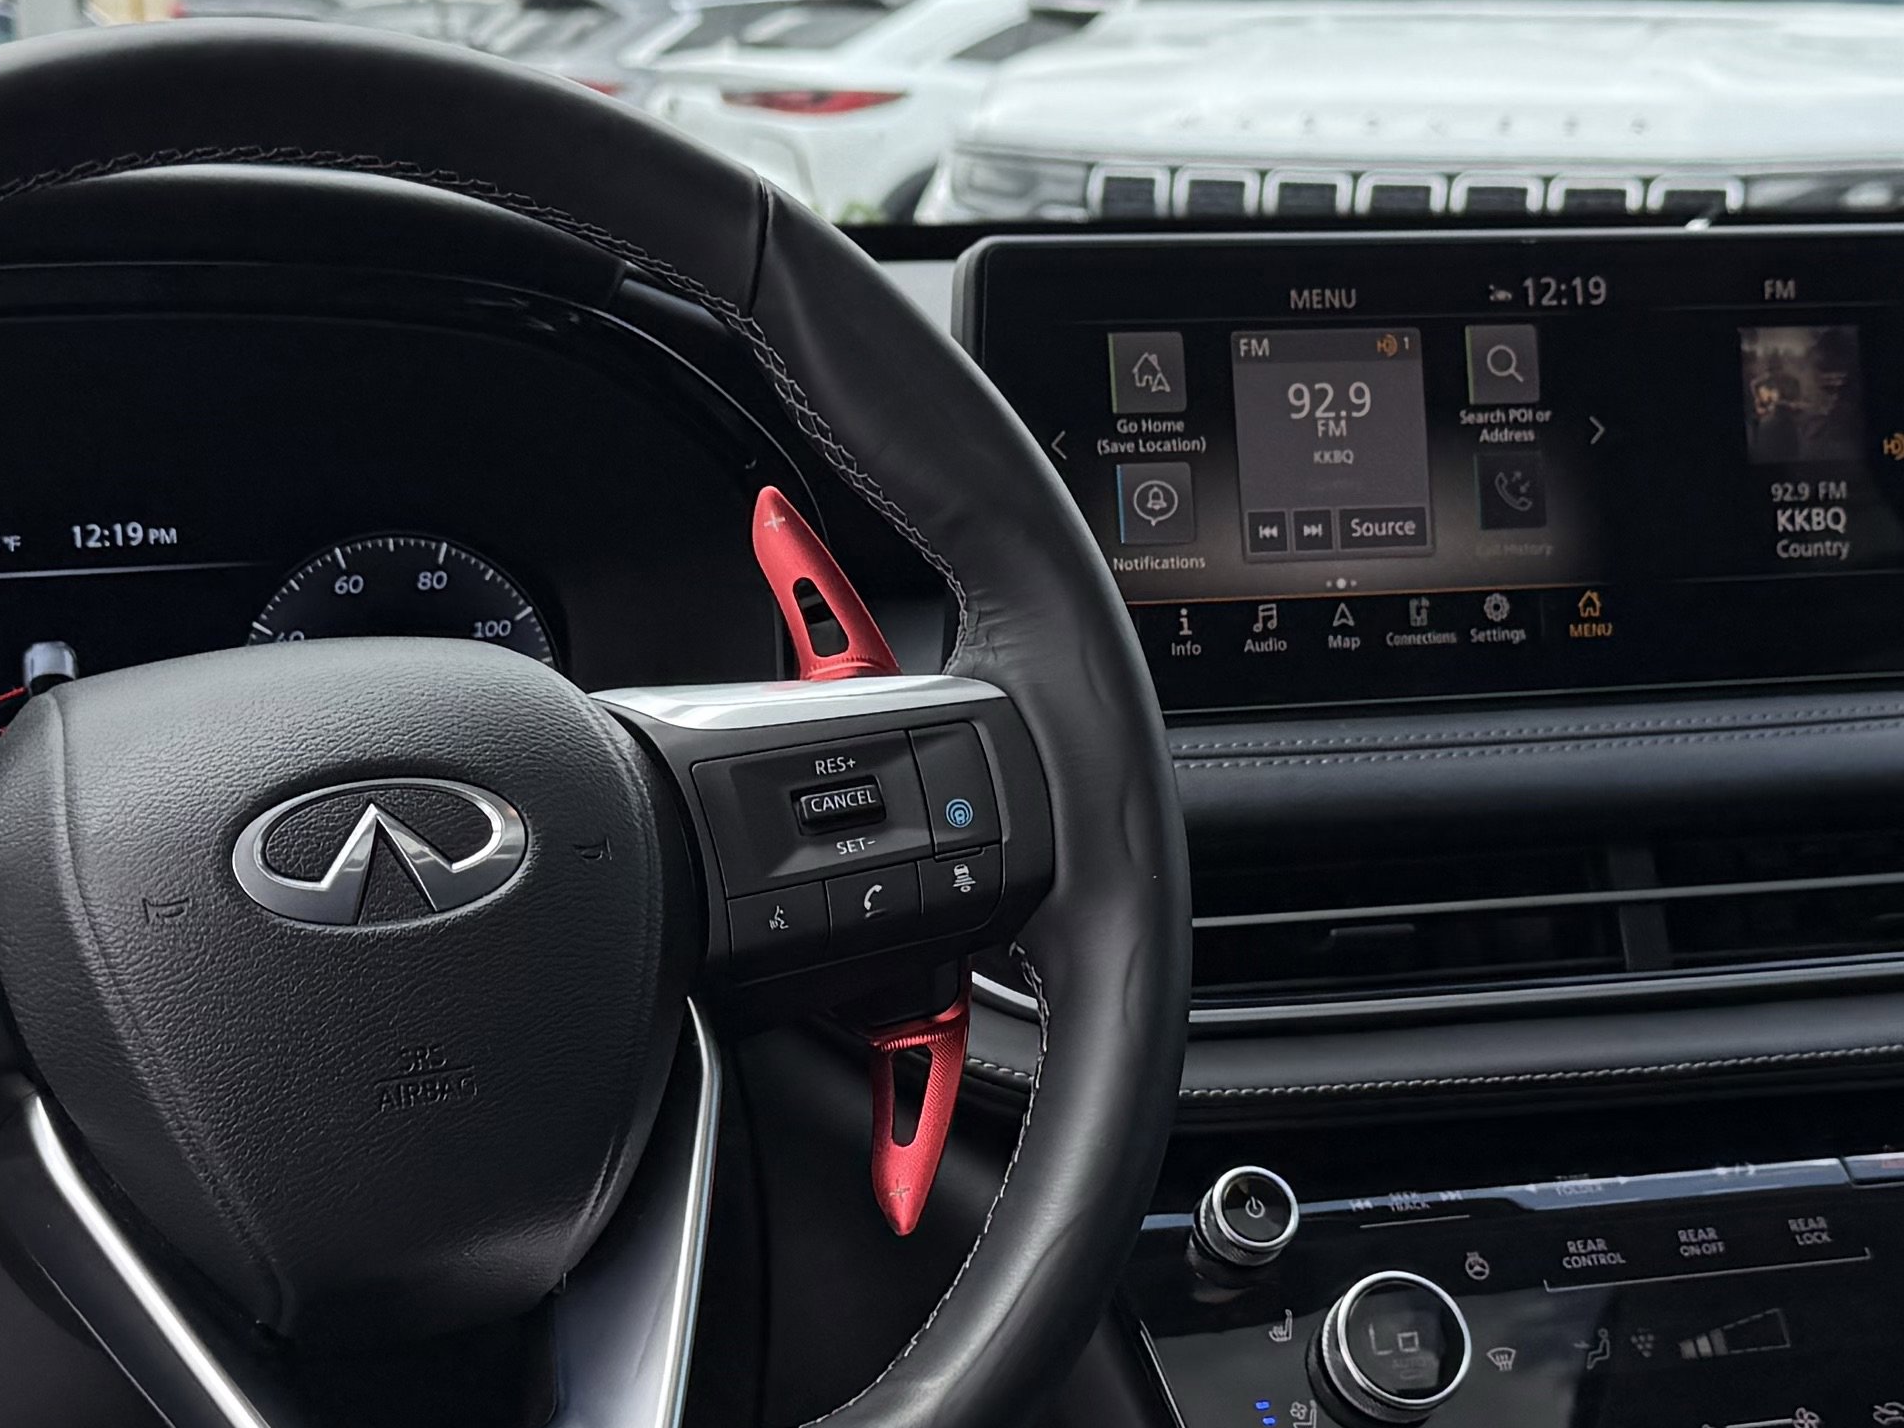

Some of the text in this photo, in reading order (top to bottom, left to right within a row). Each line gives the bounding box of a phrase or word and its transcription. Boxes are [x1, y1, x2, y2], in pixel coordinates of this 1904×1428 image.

[1290, 289, 1357, 310] MENU
[1523, 276, 1607, 307] 12:19
[1764, 280, 1795, 300] FM
[1239, 339, 1271, 358] FM
[1287, 381, 1372, 420] 92.9
[1116, 417, 1185, 434] Go Home
[1460, 408, 1551, 425] Search POI or
[1317, 420, 1347, 438] FM
[1479, 426, 1536, 443] Address
[1097, 435, 1207, 455] (Save Location)
[1313, 449, 1354, 465] KKBQ
[1771, 482, 1847, 502] 92.9 FM
[1350, 517, 1417, 538] Source
[1776, 507, 1847, 534] KKBQ
[72, 523, 177, 548] 12:19 PM
[1776, 538, 1851, 559] Country
[1113, 554, 1206, 572] Notifications
[335, 575, 364, 595] 60
[416, 571, 448, 591] 80
[473, 619, 512, 639] 100
[1386, 629, 1457, 647] Connections
[1470, 626, 1527, 645] Settings
[1569, 621, 1613, 639] MENU
[1171, 641, 1202, 657] Info
[1244, 636, 1287, 654] Audio
[1327, 634, 1361, 652] Map
[815, 756, 856, 775] RES+
[810, 789, 877, 813] CANCEL
[1788, 1215, 1828, 1233] REAR
[1678, 1227, 1718, 1244] REAR
[1794, 1228, 1832, 1246] LOCK
[1567, 1238, 1608, 1255] REAR
[1562, 1252, 1626, 1269] CONTROL
